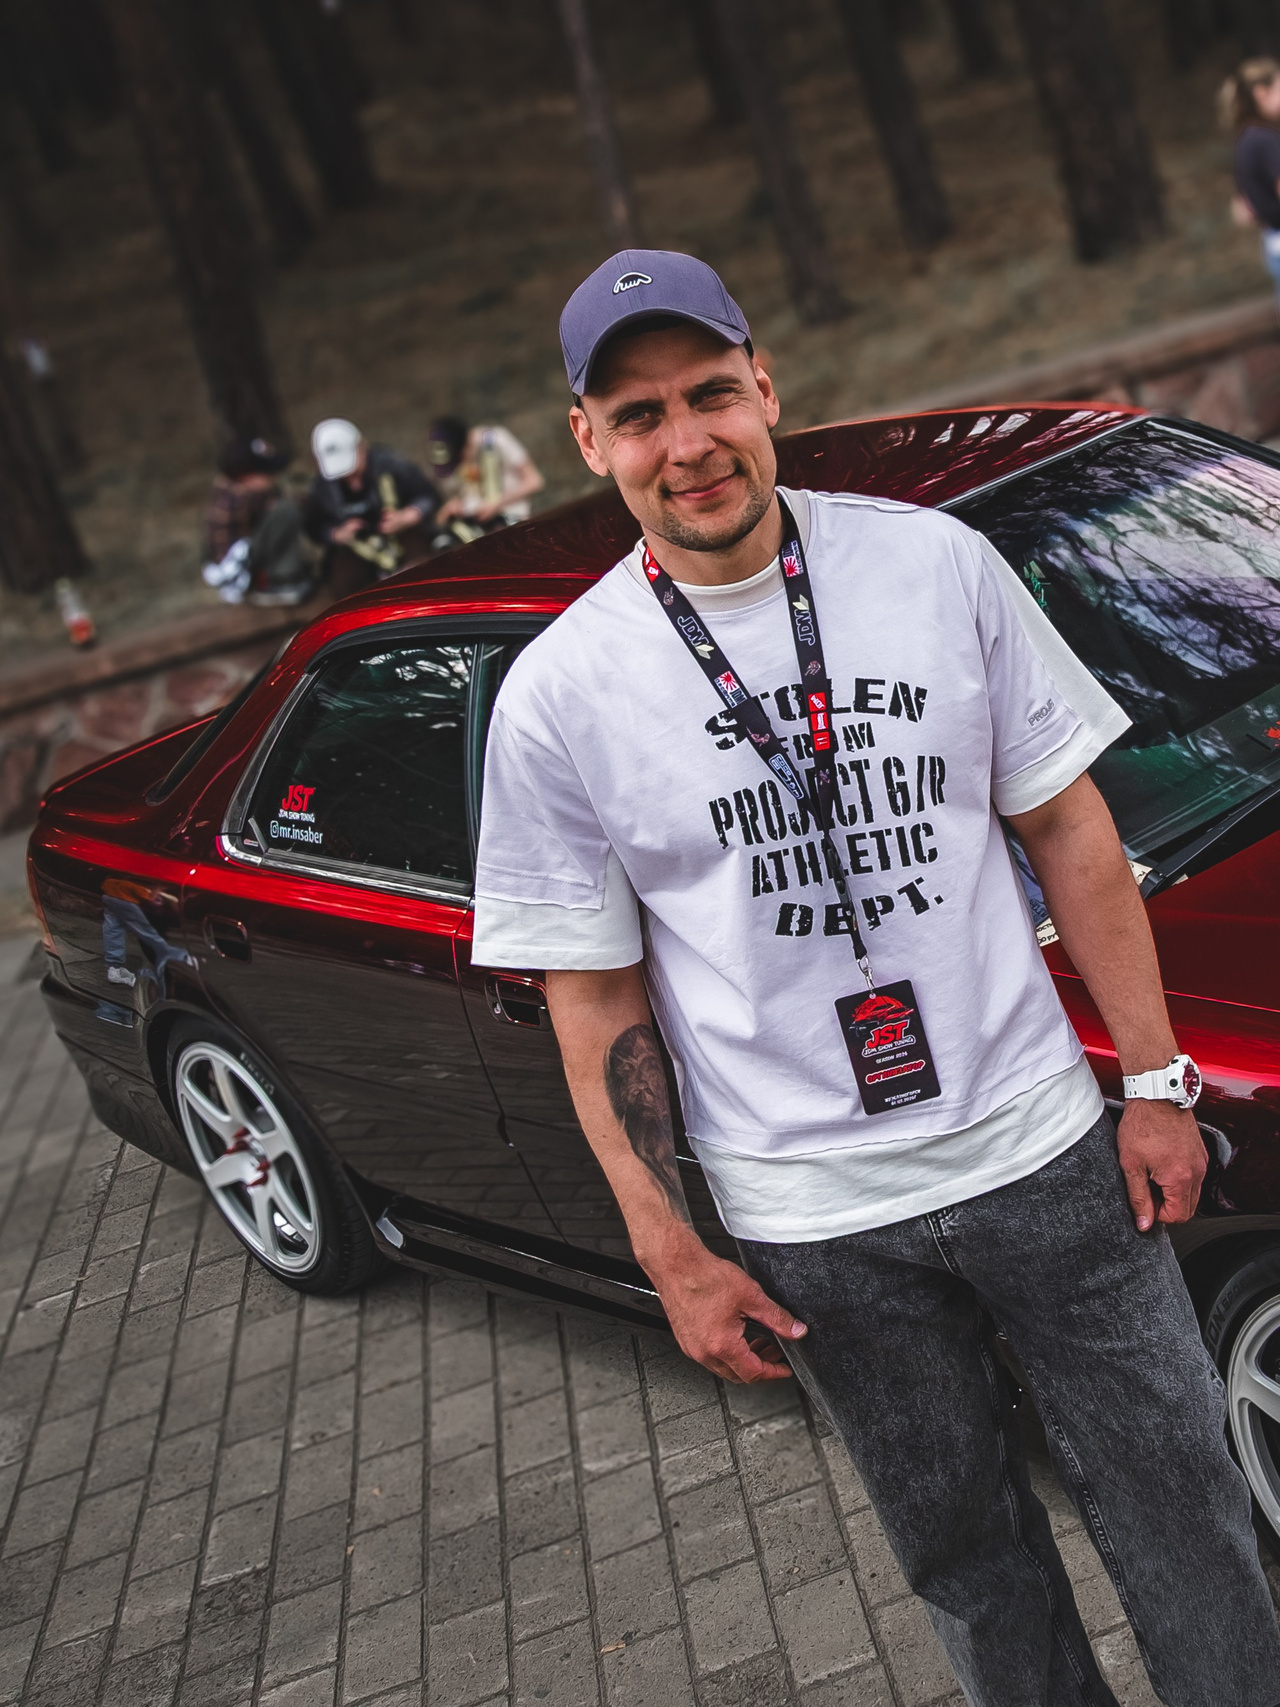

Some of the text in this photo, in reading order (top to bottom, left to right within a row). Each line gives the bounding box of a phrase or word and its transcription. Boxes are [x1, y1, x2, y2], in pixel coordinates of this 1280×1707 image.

[677, 615, 710, 647] JDM
[794, 608, 816, 647] JDM
[281, 784, 316, 812] JST
[881, 754, 947, 817] G/R
[775, 876, 944, 937] DEPT.
[867, 1021, 907, 1049] JST
